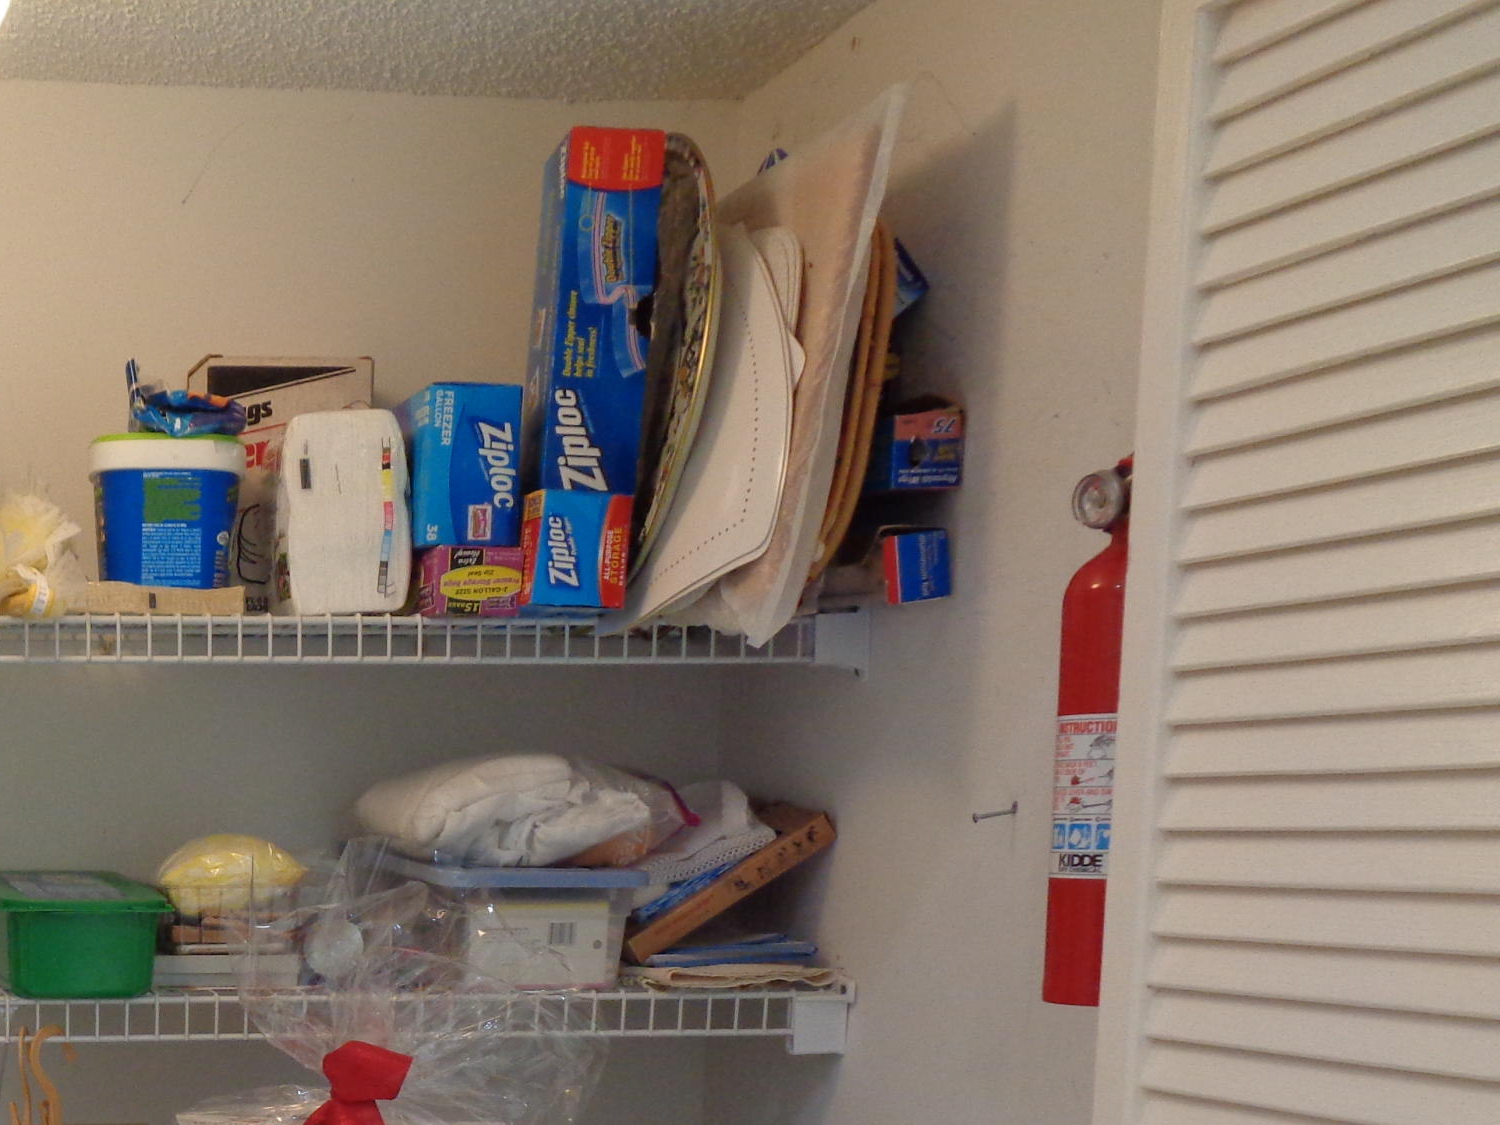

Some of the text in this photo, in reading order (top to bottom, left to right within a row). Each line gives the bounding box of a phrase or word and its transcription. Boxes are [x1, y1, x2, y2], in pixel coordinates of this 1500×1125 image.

[441, 390, 455, 446] FREEZER
[555, 388, 608, 491] Ziploc
[478, 421, 517, 509] Ziploc
[426, 523, 438, 541] 38
[548, 517, 580, 588] Ziploc
[610, 526, 622, 585] STORAGE
[1058, 854, 1104, 867] KIDDE
